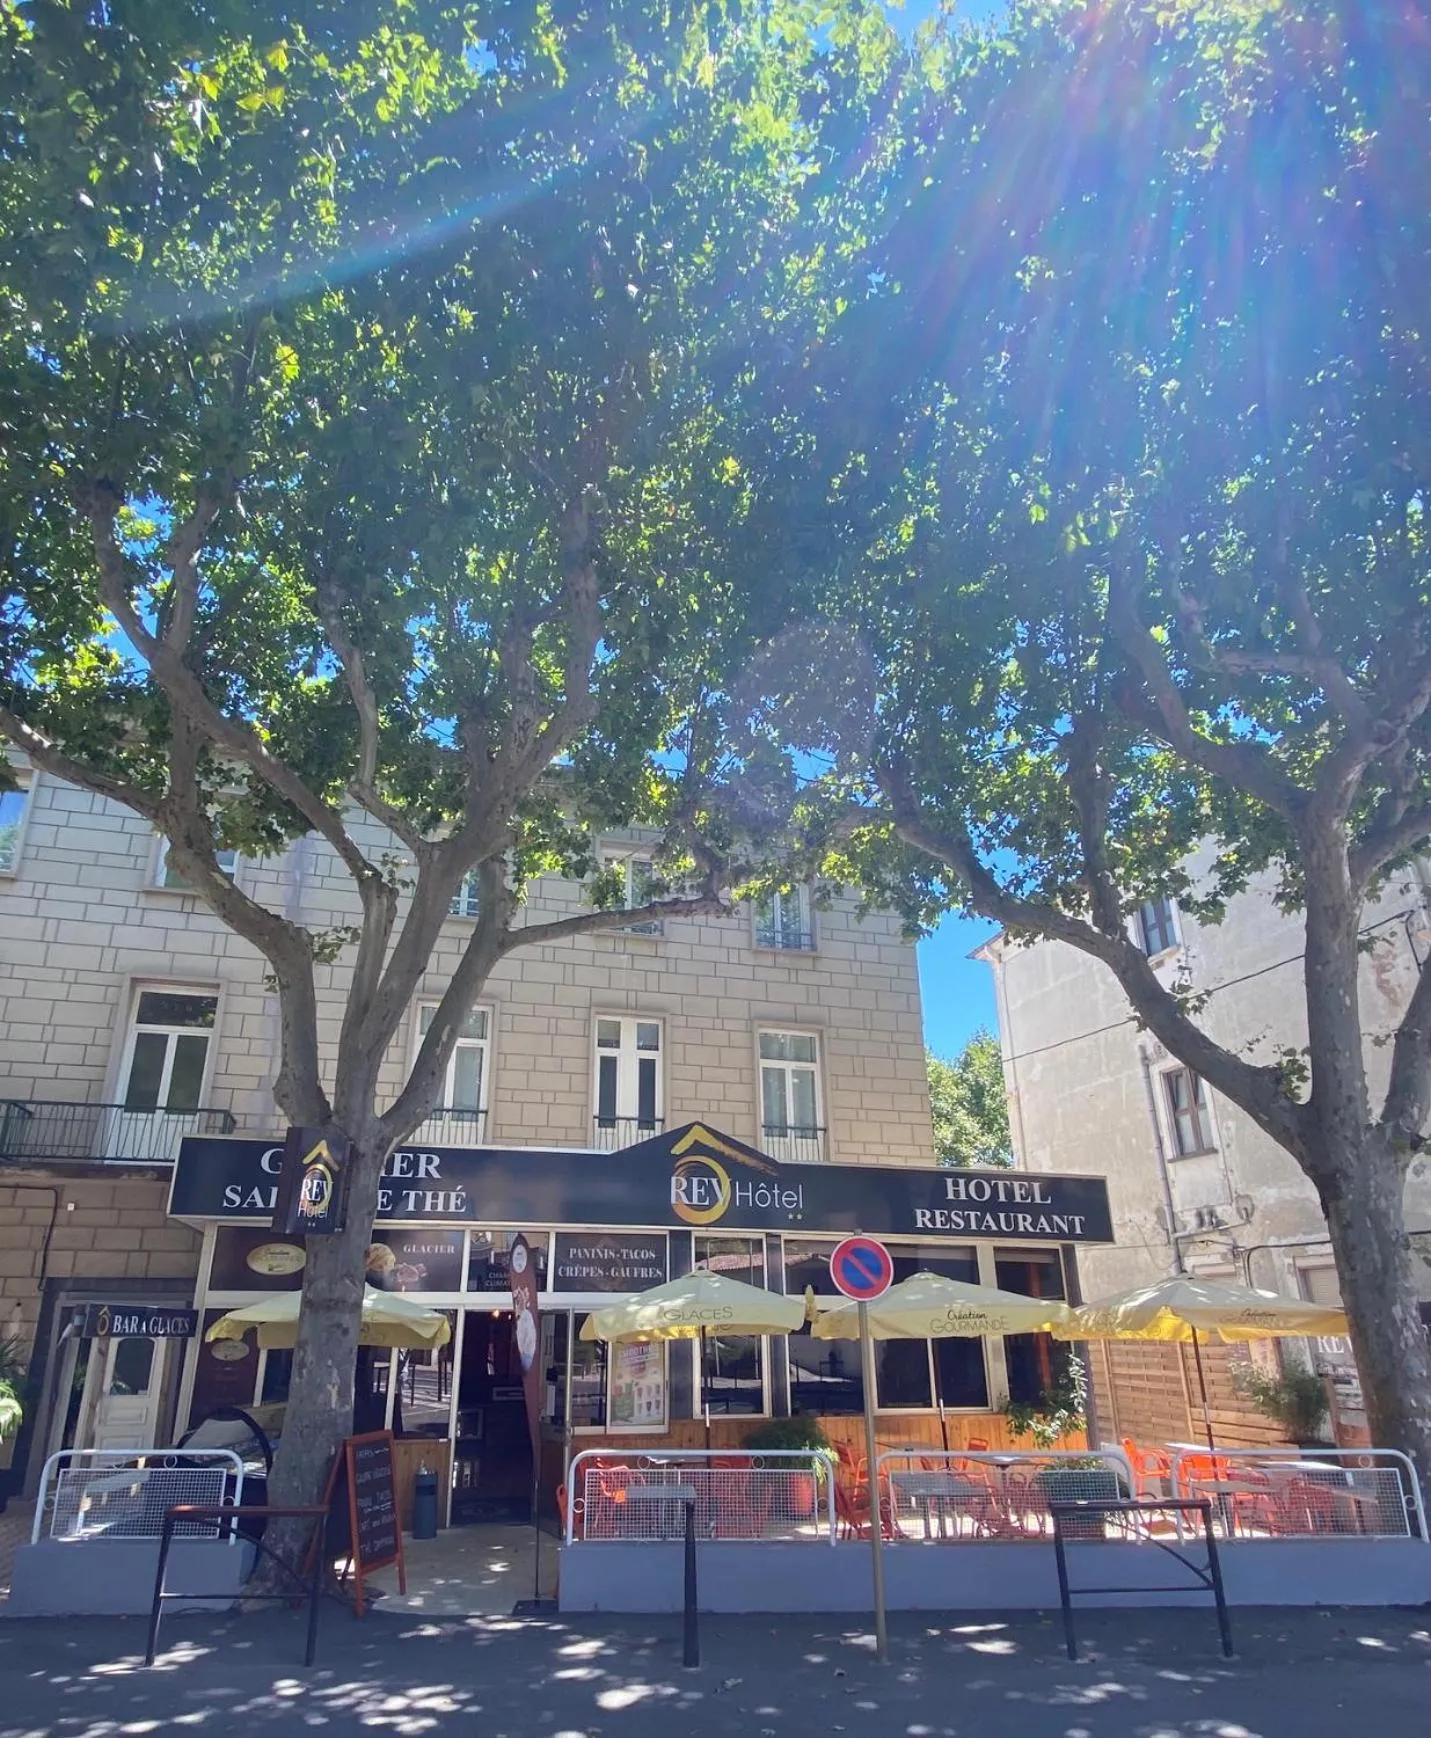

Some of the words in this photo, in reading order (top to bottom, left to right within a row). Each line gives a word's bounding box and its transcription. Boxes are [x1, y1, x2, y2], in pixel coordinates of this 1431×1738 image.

[402, 1183, 467, 1214] THÉ
[735, 1180, 804, 1209] Hôtel
[944, 1177, 1052, 1205] HOTEL
[914, 1208, 1086, 1236] RESTAURANT
[403, 1243, 456, 1255] GLACIER
[112, 1314, 139, 1334] BAR
[149, 1316, 190, 1335] GLACES
[663, 1306, 734, 1322] GLACES
[929, 1315, 1012, 1334] GOURMANDE
